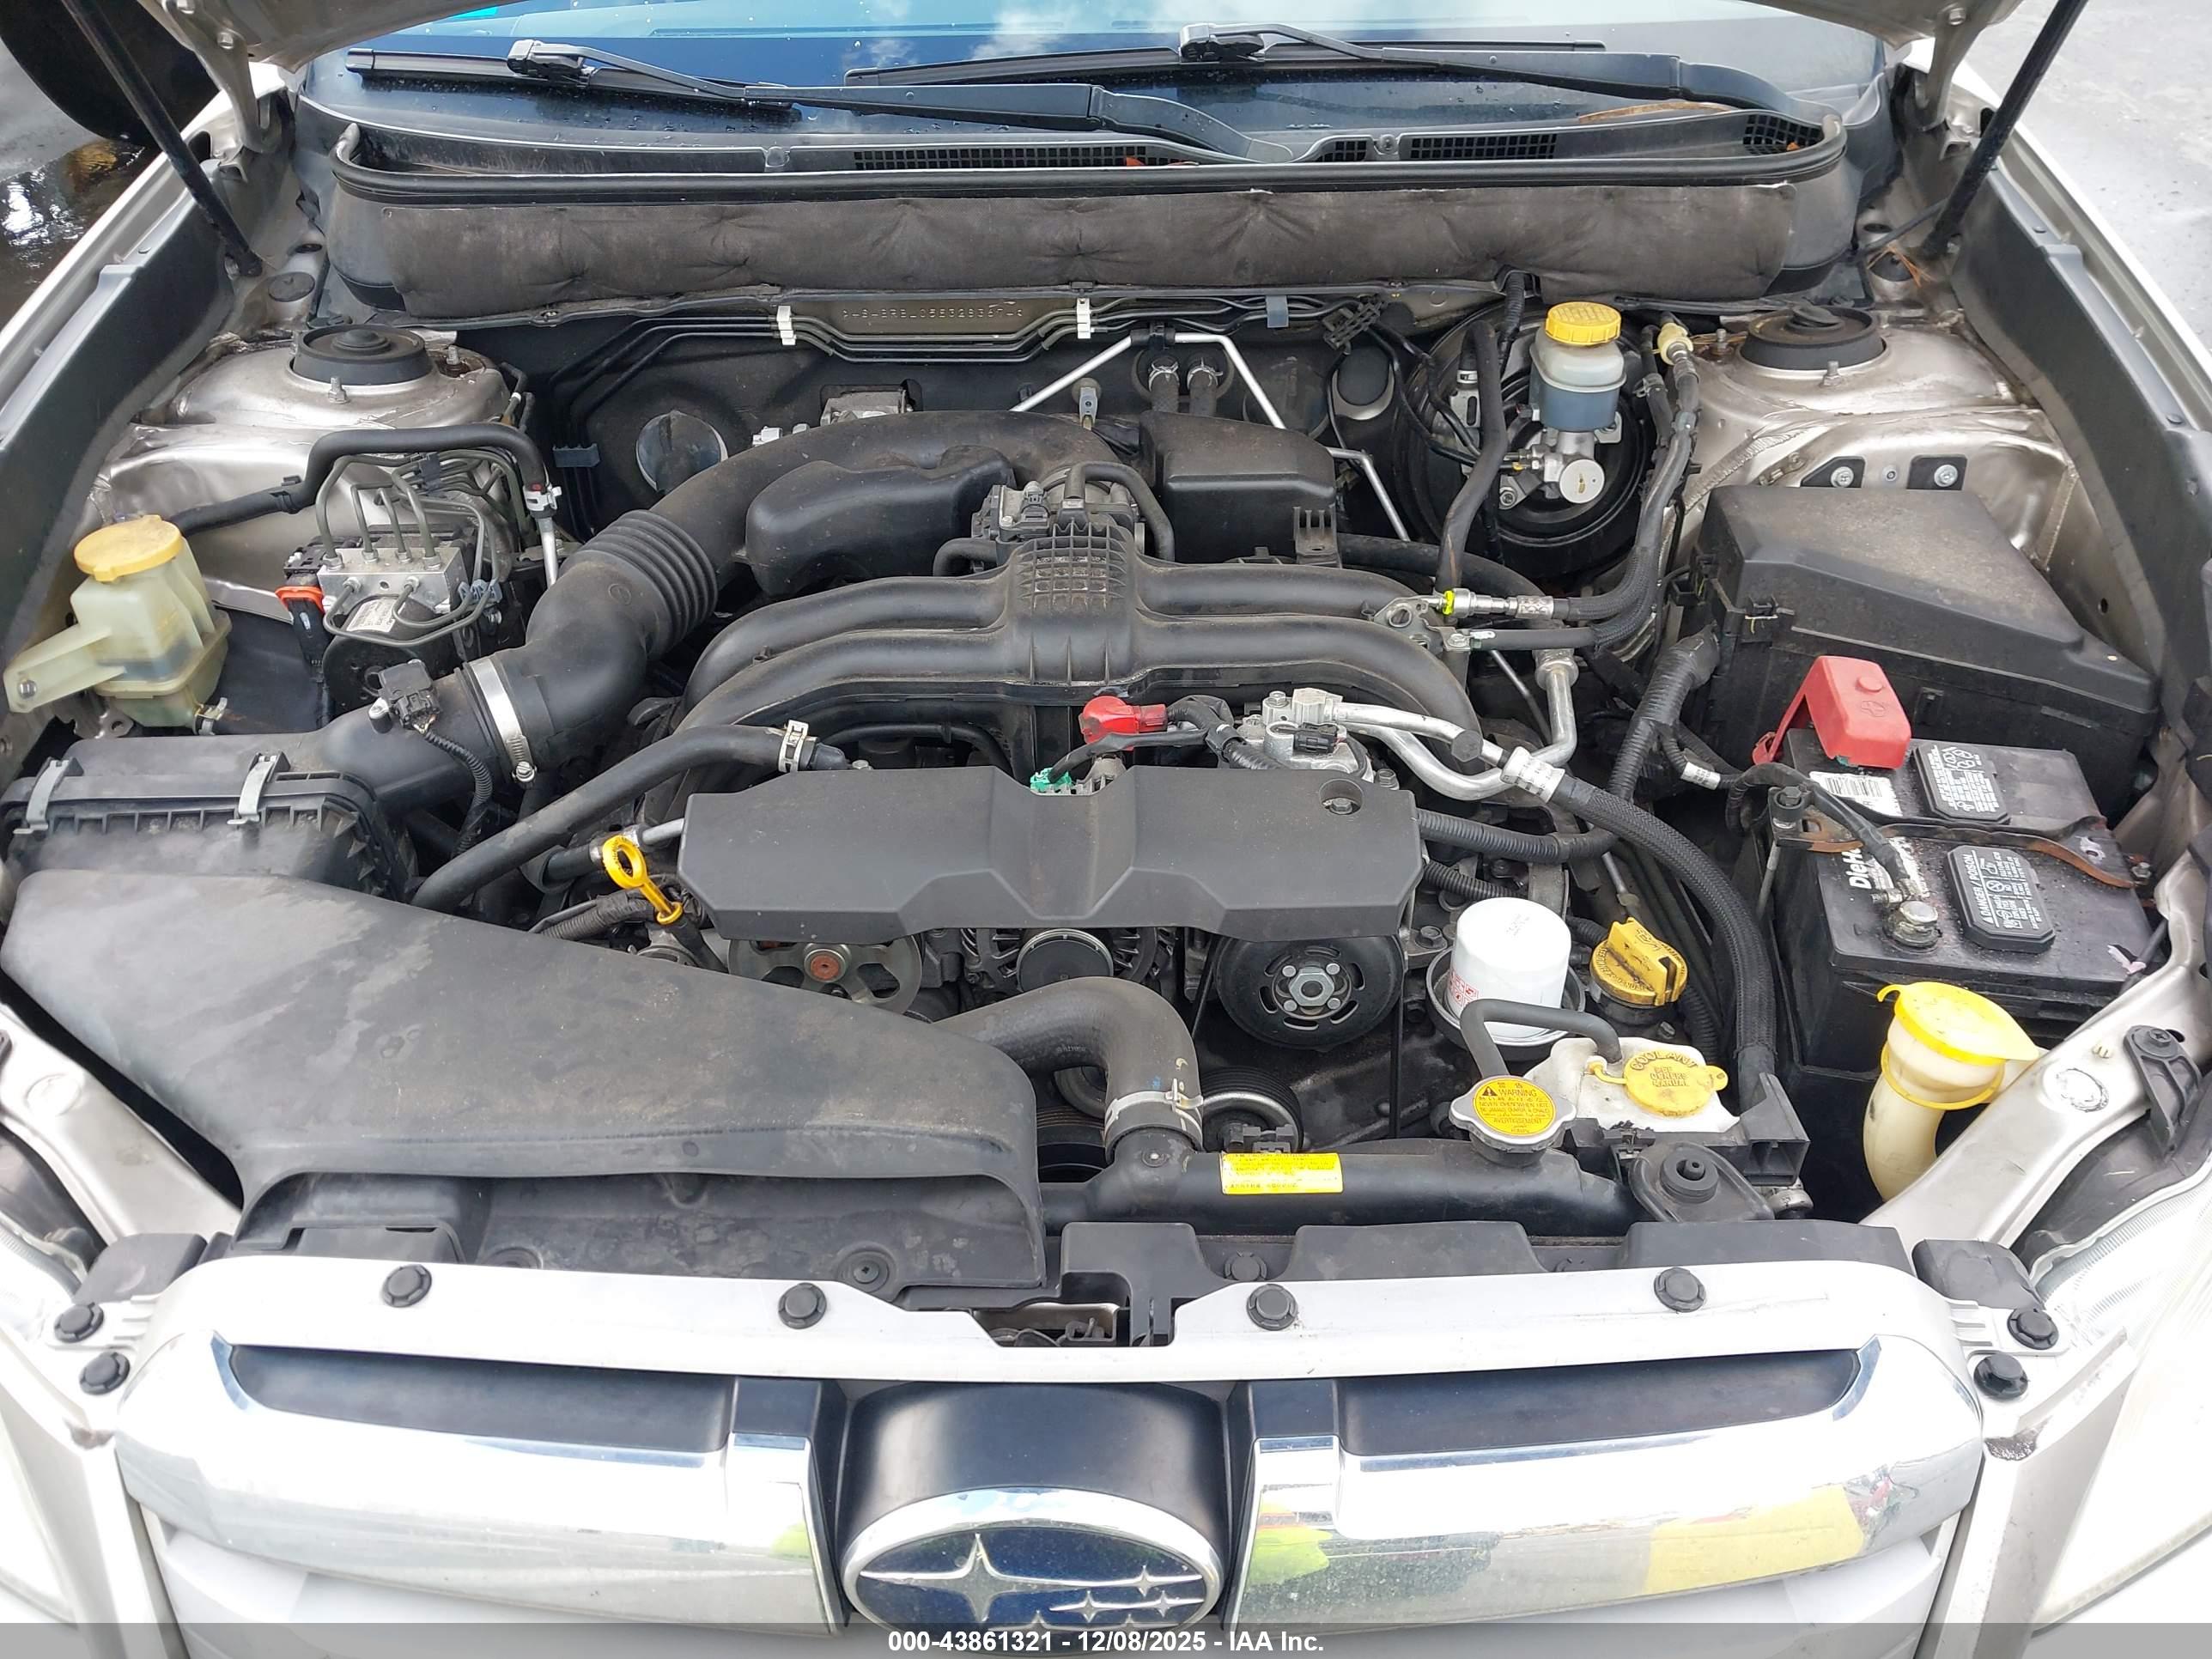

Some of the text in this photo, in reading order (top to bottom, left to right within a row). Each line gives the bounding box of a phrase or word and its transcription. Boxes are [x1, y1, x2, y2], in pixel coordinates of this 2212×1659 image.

[1962, 854, 1981, 881] POISON
[1973, 886, 1992, 917] DANGER
[1630, 1050, 1698, 1071] COOLANT
[1498, 1089, 1538, 1097] WARNING
[1651, 1079, 1690, 1088] MANUAL
